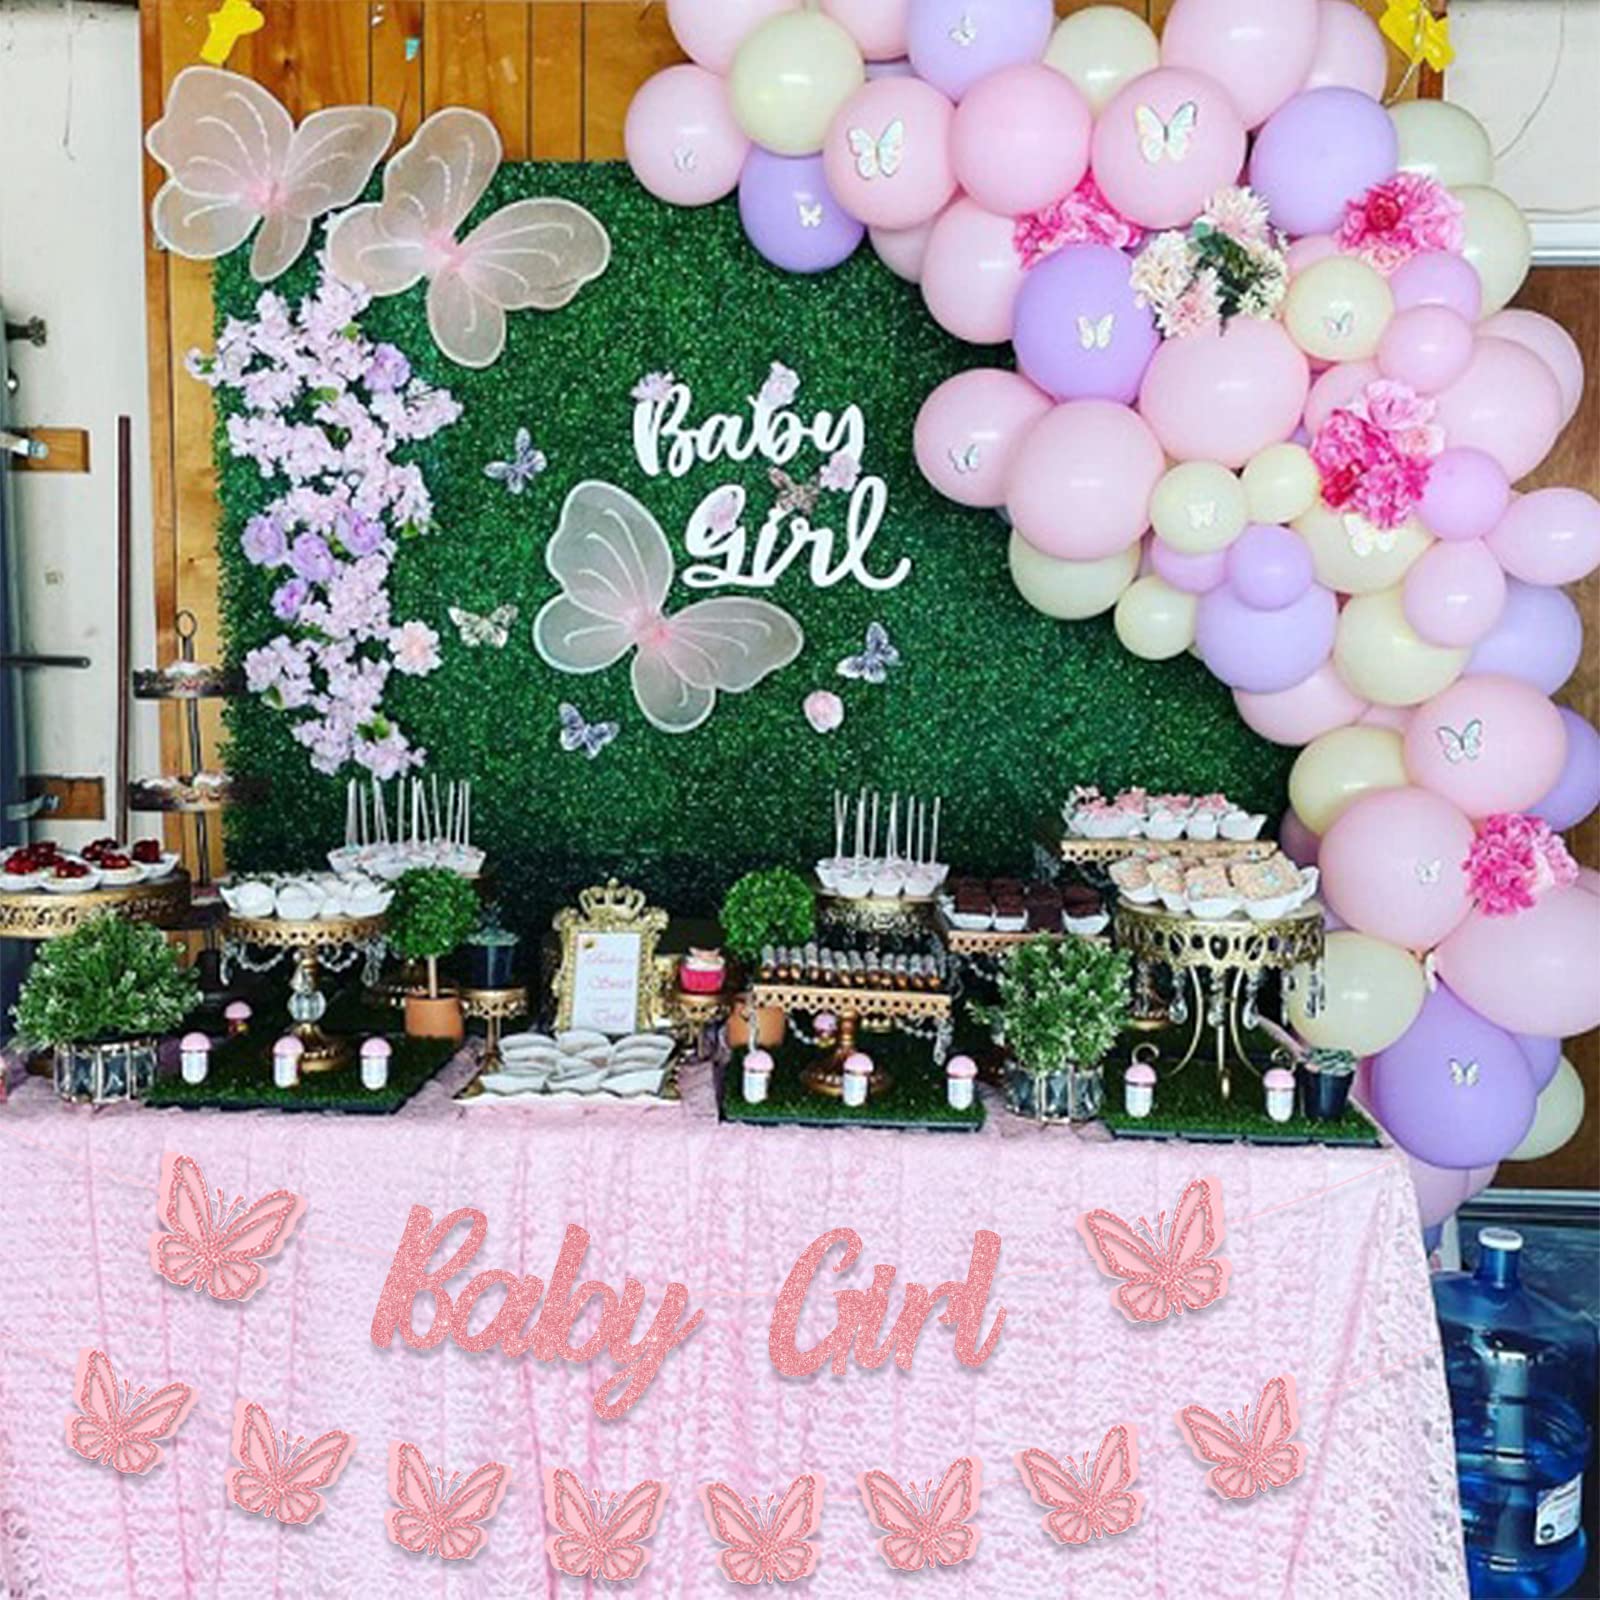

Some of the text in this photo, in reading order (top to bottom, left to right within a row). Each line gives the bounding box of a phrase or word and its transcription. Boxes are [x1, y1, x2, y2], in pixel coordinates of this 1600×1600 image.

[633, 383, 865, 477] Baby
[682, 475, 911, 590] Girl
[370, 1203, 1007, 1420] Baby Girl
